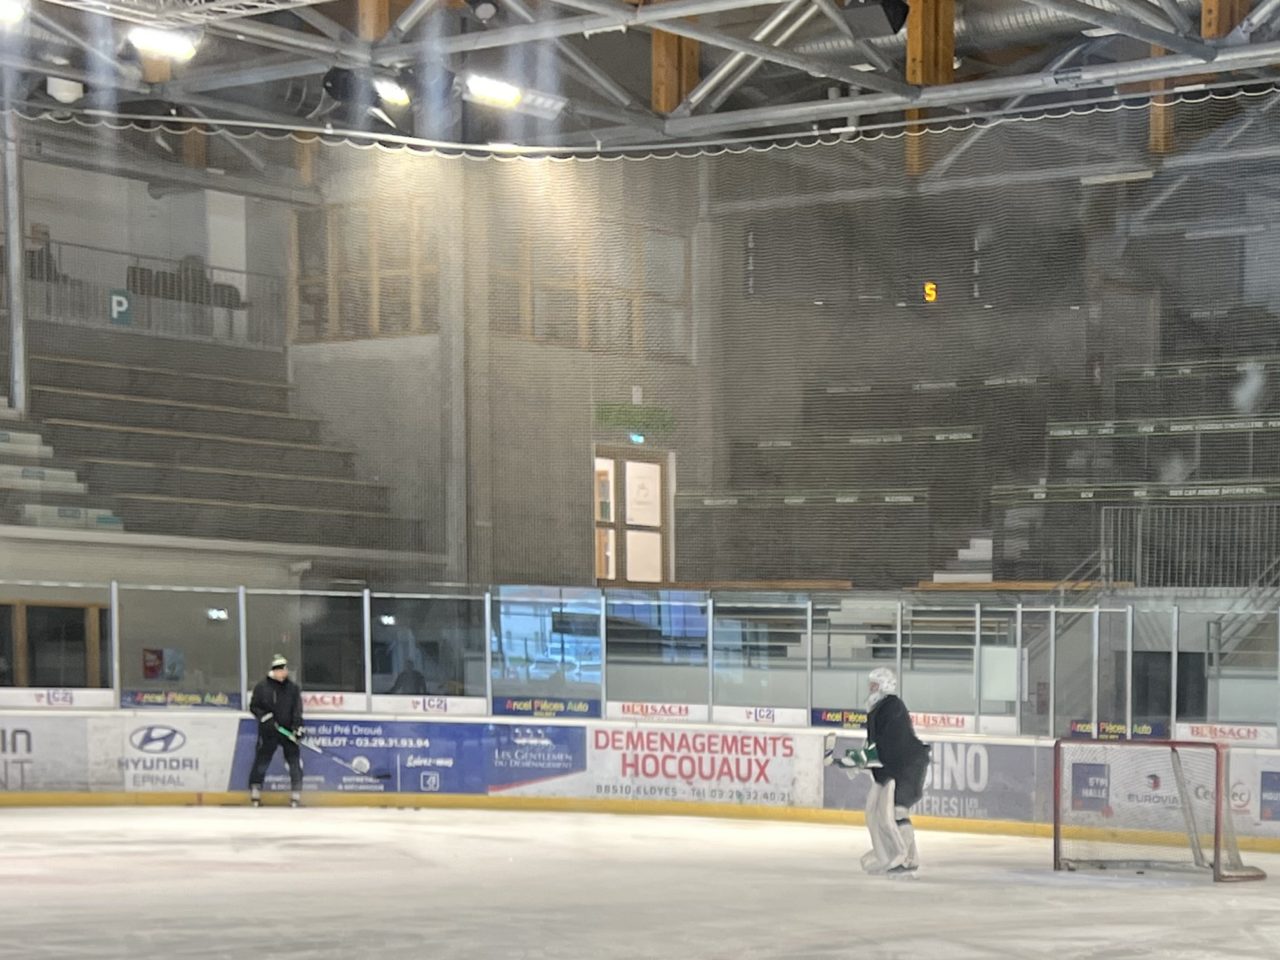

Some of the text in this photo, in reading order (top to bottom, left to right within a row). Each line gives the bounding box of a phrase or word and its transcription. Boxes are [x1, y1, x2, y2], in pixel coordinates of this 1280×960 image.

[112, 295, 128, 318] P
[506, 699, 532, 711] Ancel
[567, 701, 589, 713] Auto
[821, 711, 842, 722] Ancel
[318, 725, 332, 735] du
[1132, 724, 1152, 735] Auto
[594, 730, 795, 758] DEMENAGEMENTS
[117, 757, 199, 771] HYUNDAI
[621, 753, 771, 785] HOCQUAUX
[923, 742, 989, 792] INO
[132, 774, 185, 787] EPINAL
